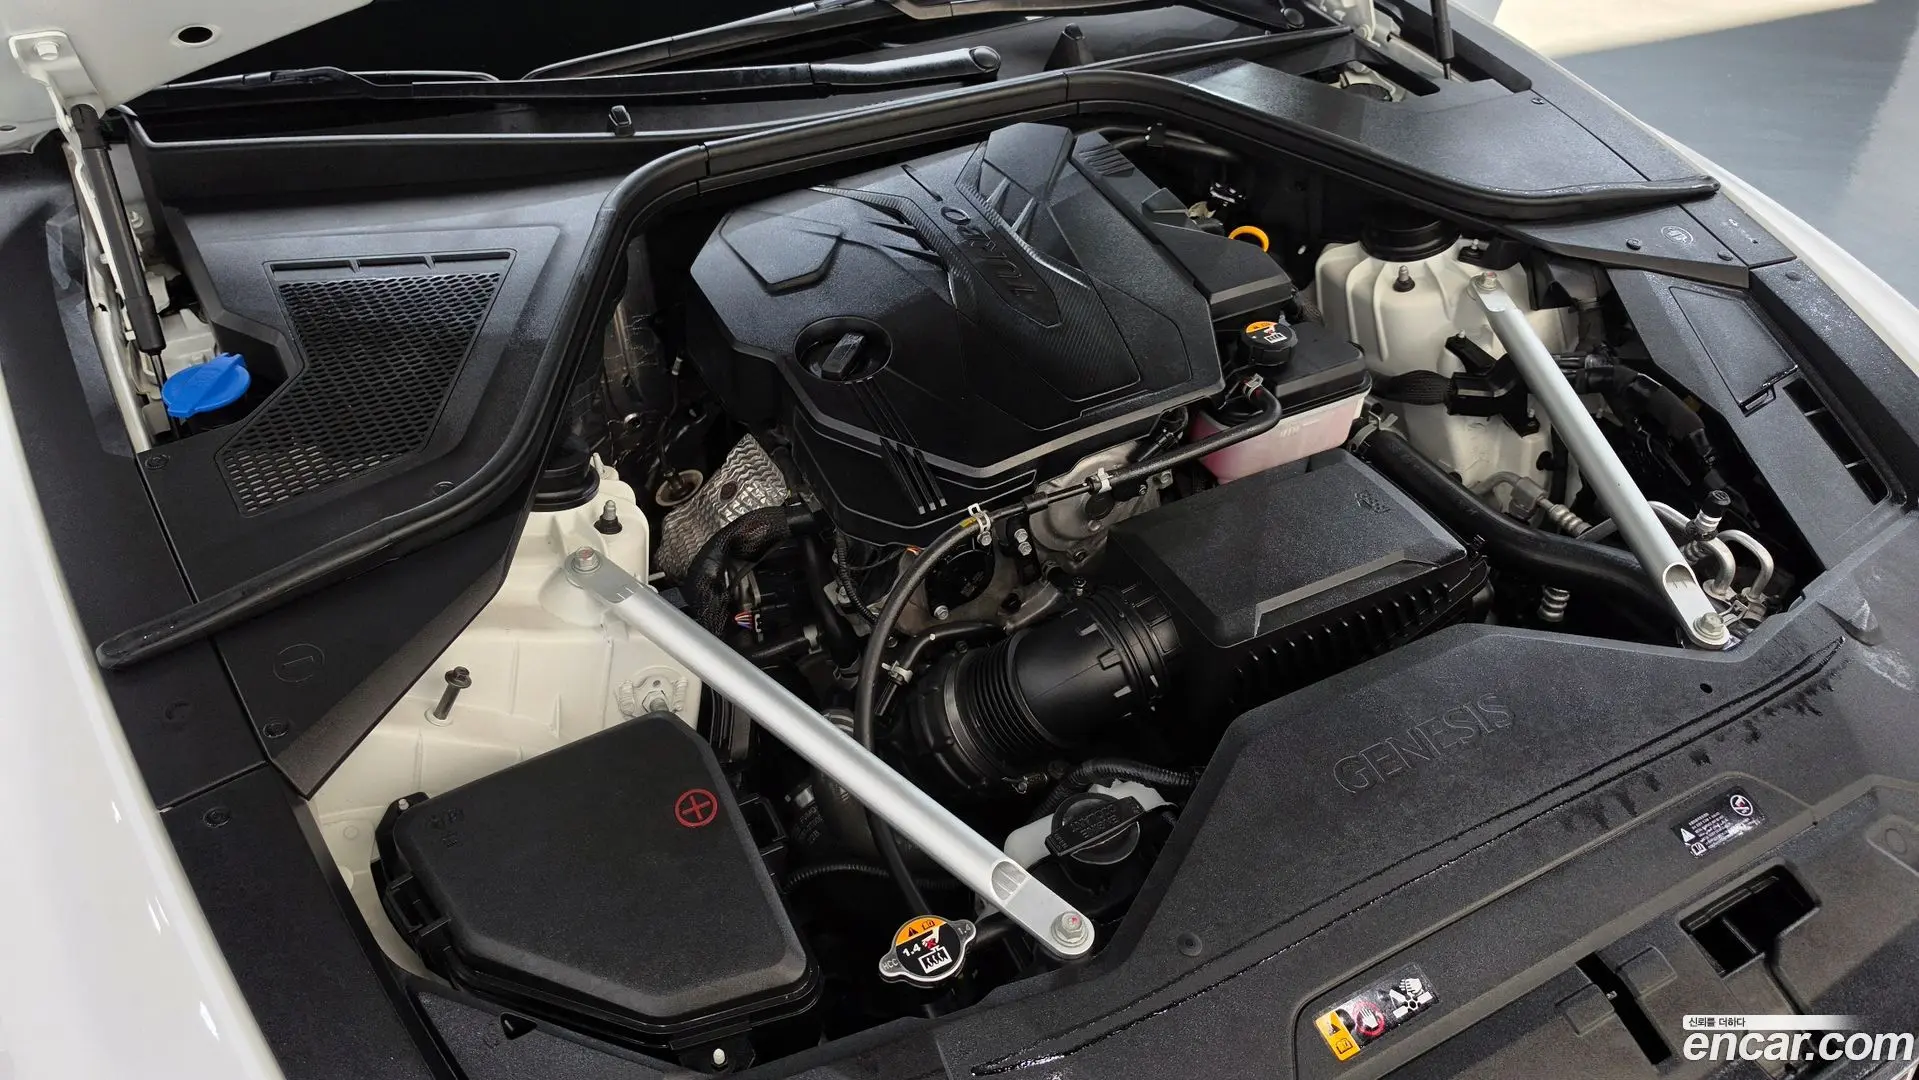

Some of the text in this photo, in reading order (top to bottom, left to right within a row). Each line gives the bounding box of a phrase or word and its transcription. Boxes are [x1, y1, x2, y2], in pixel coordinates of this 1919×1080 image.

[1333, 693, 1516, 794] GENESIS
[902, 942, 922, 957] 1.4
[882, 958, 900, 971] HCC
